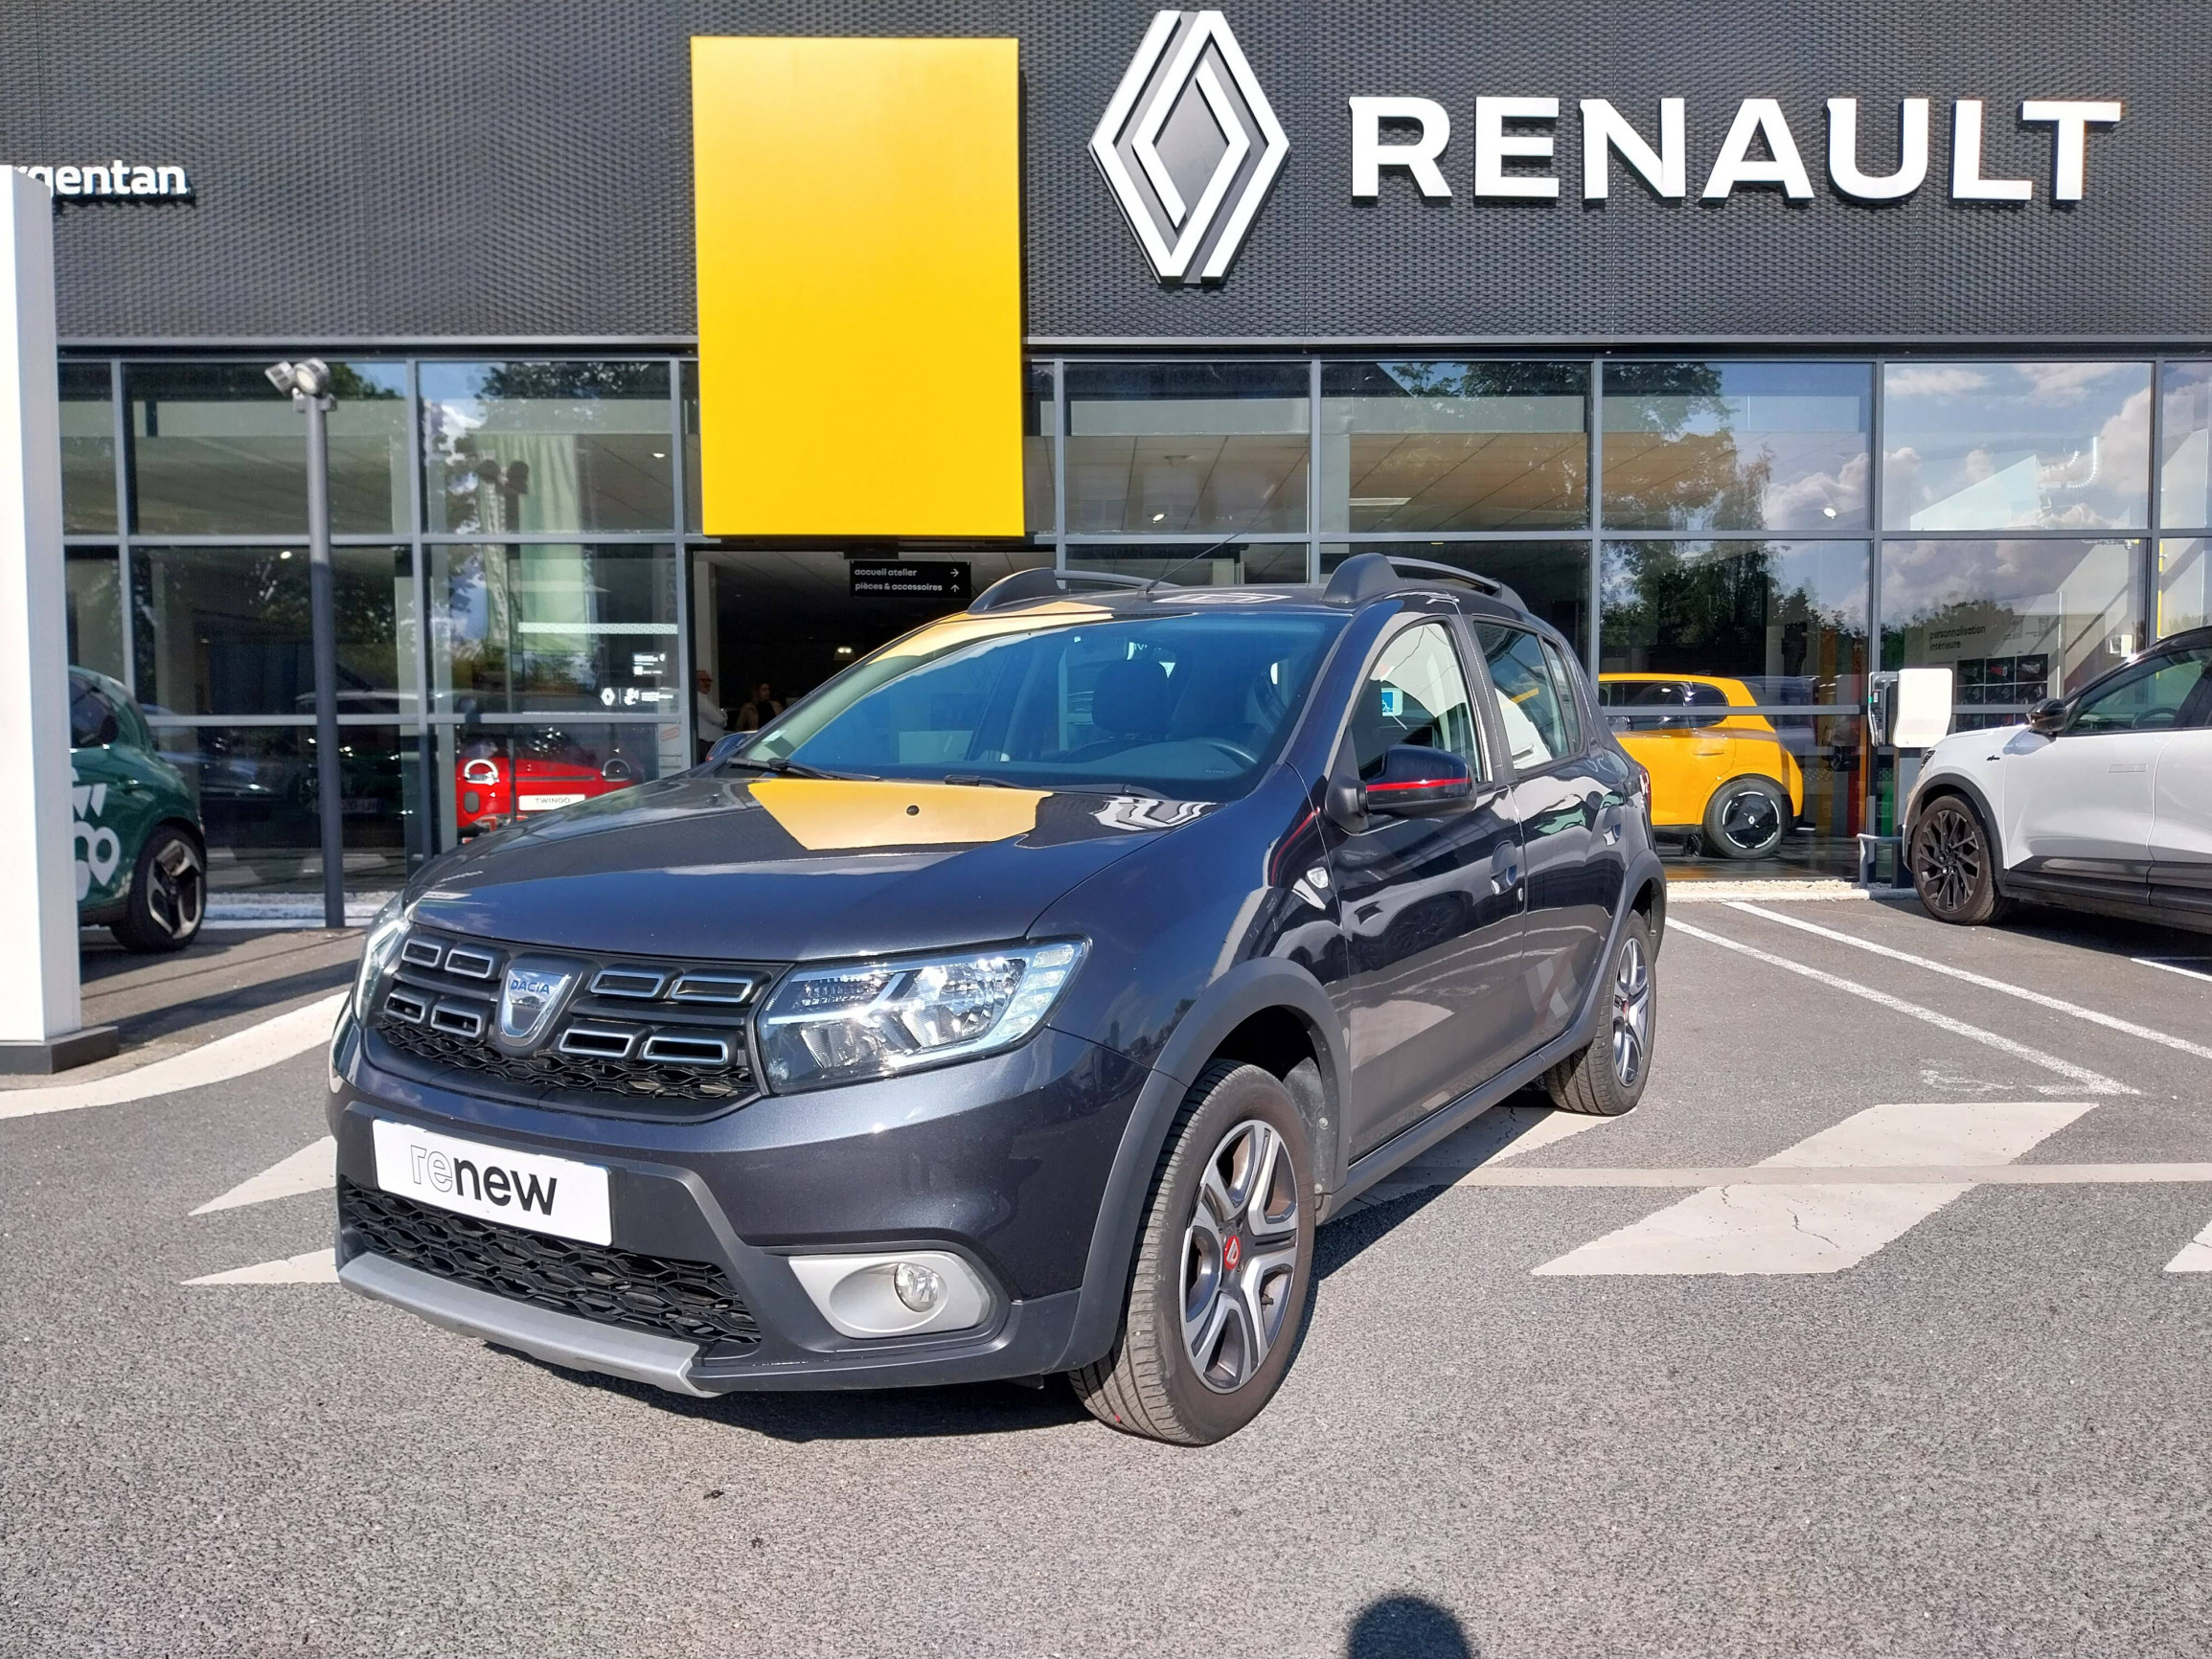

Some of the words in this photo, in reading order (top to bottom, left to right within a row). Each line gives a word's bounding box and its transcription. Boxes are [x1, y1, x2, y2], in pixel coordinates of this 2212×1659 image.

[1348, 96, 2122, 200] RENAULT
[855, 568, 887, 577] accueil
[888, 568, 918, 577] atelier
[855, 582, 883, 591] pièces
[892, 582, 943, 591] accessoires
[1929, 625, 1986, 640] personnalisation
[1929, 641, 1961, 651] intérieure
[410, 1145, 558, 1216] renew
